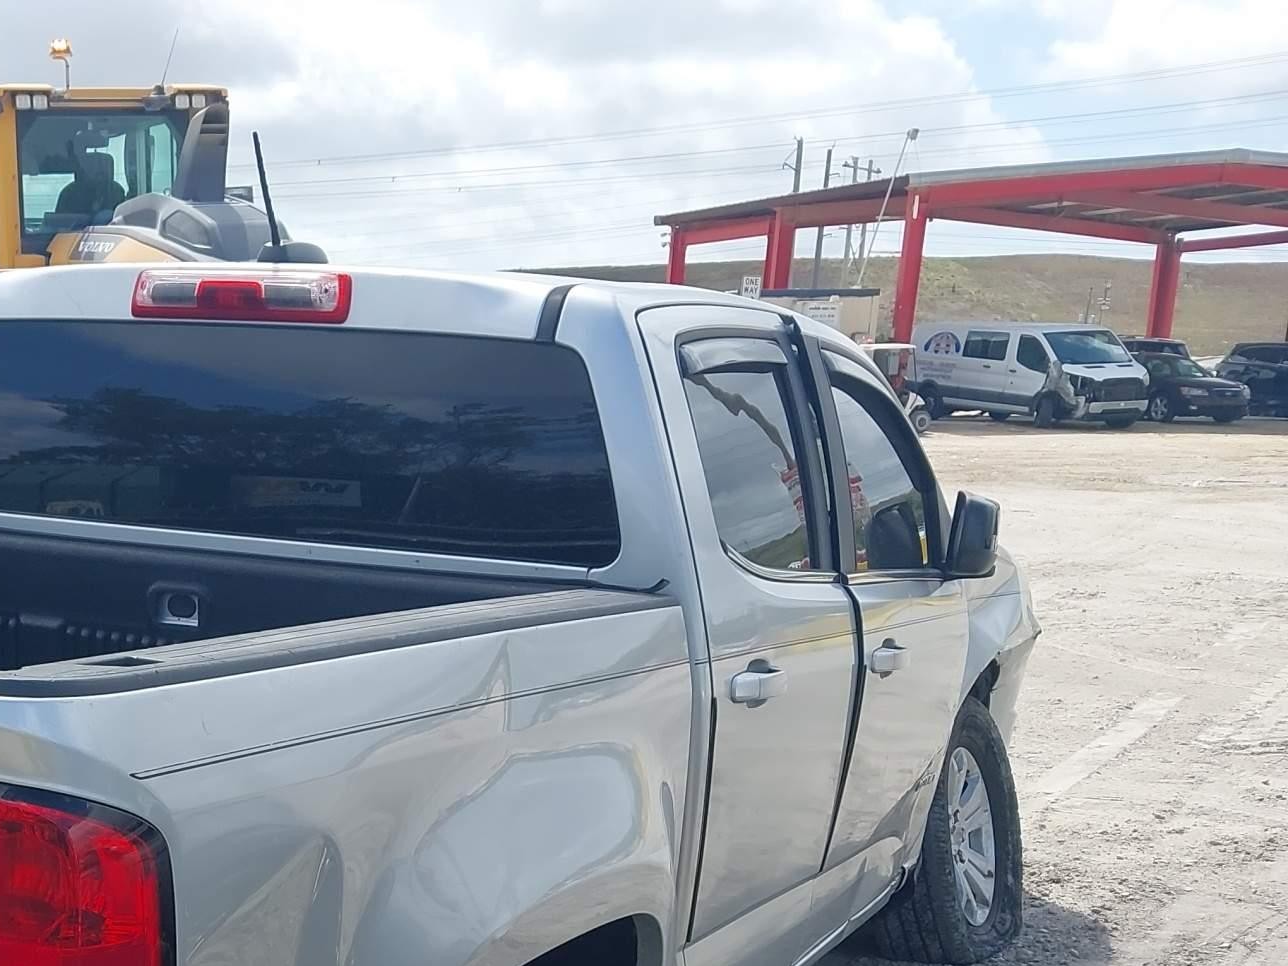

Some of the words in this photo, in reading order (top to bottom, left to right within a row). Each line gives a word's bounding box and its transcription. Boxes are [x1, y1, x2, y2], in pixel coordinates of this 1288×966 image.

[78, 241, 115, 253] VOLVO
[745, 278, 759, 286] ONE
[743, 286, 759, 295] WAY
